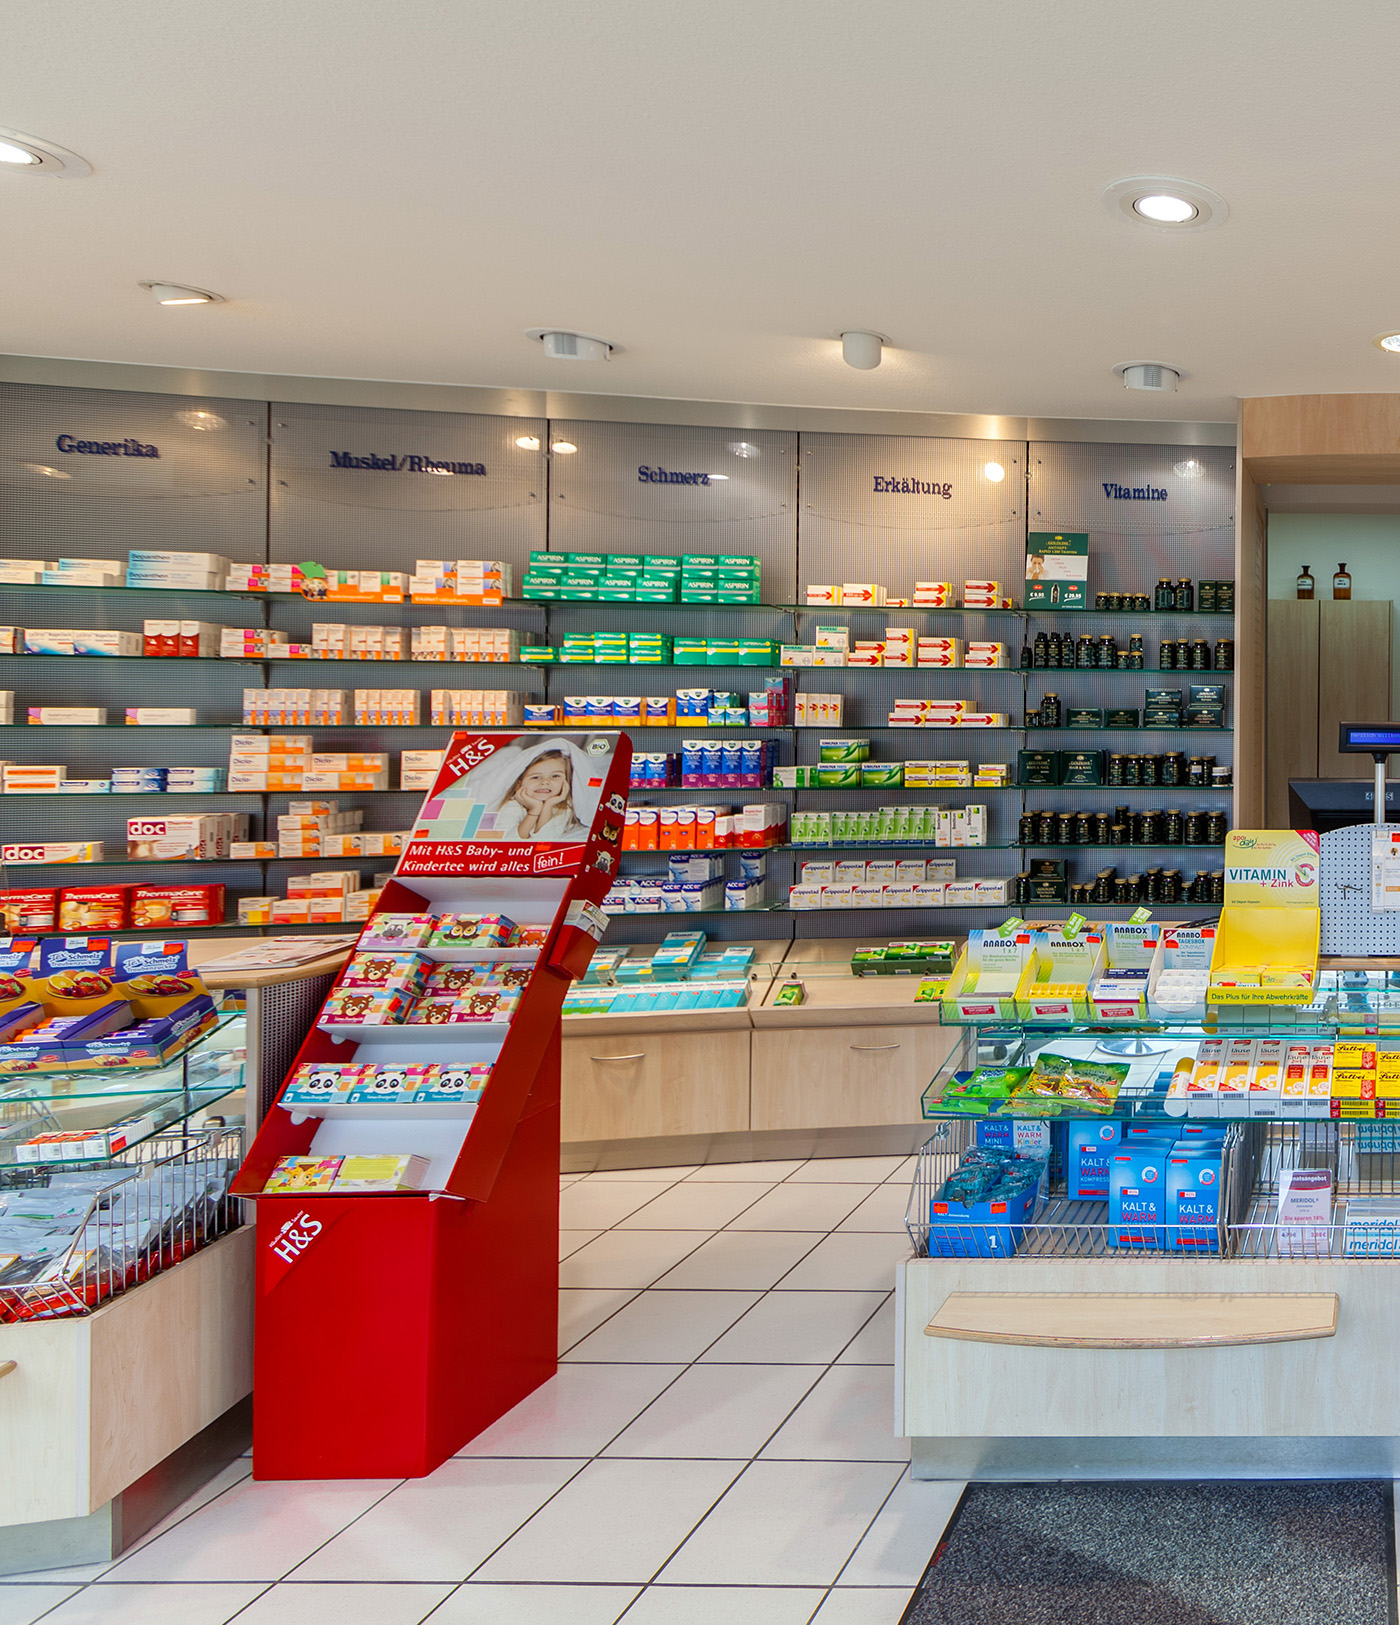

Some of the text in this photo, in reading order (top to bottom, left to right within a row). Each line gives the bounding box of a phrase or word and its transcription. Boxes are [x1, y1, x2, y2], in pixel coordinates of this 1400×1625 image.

[56, 434, 159, 460] Generika
[329, 451, 487, 477] Muskel/Rheuma
[637, 464, 711, 488] Schmerz
[873, 476, 952, 500] Erkältung
[1102, 483, 1168, 501] Vitamine
[605, 579, 631, 587] ASPIRIN
[449, 738, 495, 777] H&S
[231, 776, 251, 784] Diclo-
[130, 822, 165, 836] doc
[1233, 835, 1257, 849] apo day
[4, 847, 44, 860] doc
[409, 845, 533, 858] Mit H&S Baby- und
[403, 852, 564, 872] Kindertee wird alles fein!
[1230, 869, 1286, 881] VITAMIN
[1271, 879, 1294, 888] Zink
[65, 893, 120, 901] ThermaCare
[136, 890, 204, 899] ThermaCare
[1177, 931, 1201, 939] ANABO
[983, 940, 1017, 948] ANABOX
[1123, 1202, 1156, 1211] KALT &
[1180, 1204, 1213, 1213] KALT &
[1122, 1212, 1156, 1222] WARM
[1180, 1215, 1214, 1224] WARM
[273, 1213, 322, 1263] H&S
[989, 1235, 997, 1249] 1
[1350, 1238, 1398, 1251] meridol
